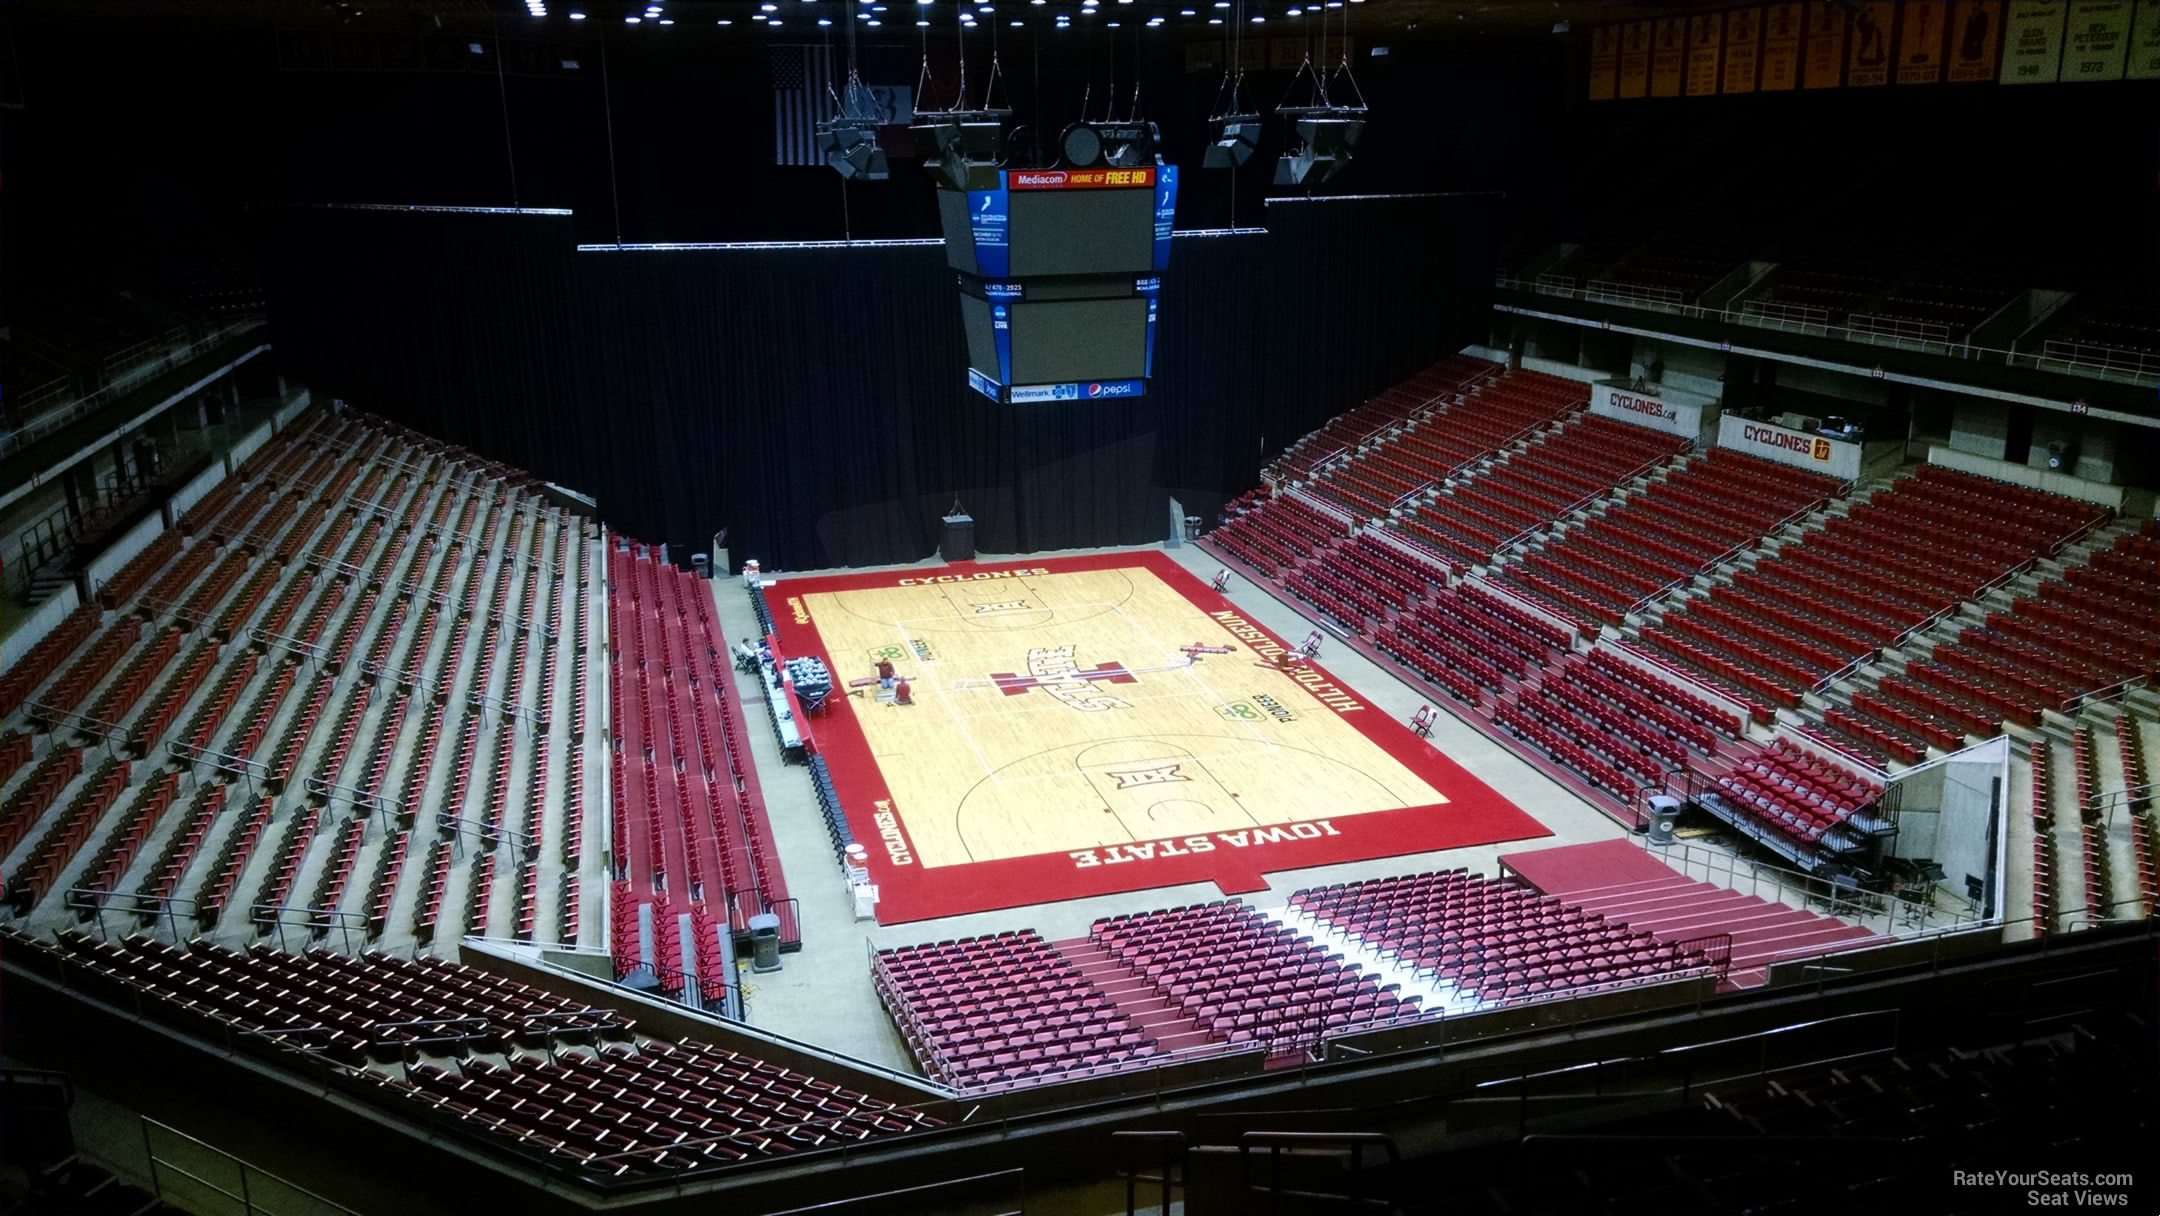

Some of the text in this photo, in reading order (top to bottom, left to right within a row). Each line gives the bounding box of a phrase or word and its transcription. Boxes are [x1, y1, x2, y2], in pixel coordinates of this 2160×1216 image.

[1018, 171, 1147, 186] Mediacom HOME OF FREE HD
[1012, 390, 1049, 398] Wellmark
[1103, 384, 1131, 396] pepsi
[2073, 404, 2086, 414] 134
[1744, 425, 1811, 455] CYCLONES
[899, 567, 1049, 586] CYCLONES
[1252, 694, 1298, 723] PIONEER
[1069, 820, 1341, 868] IOWA STATE
